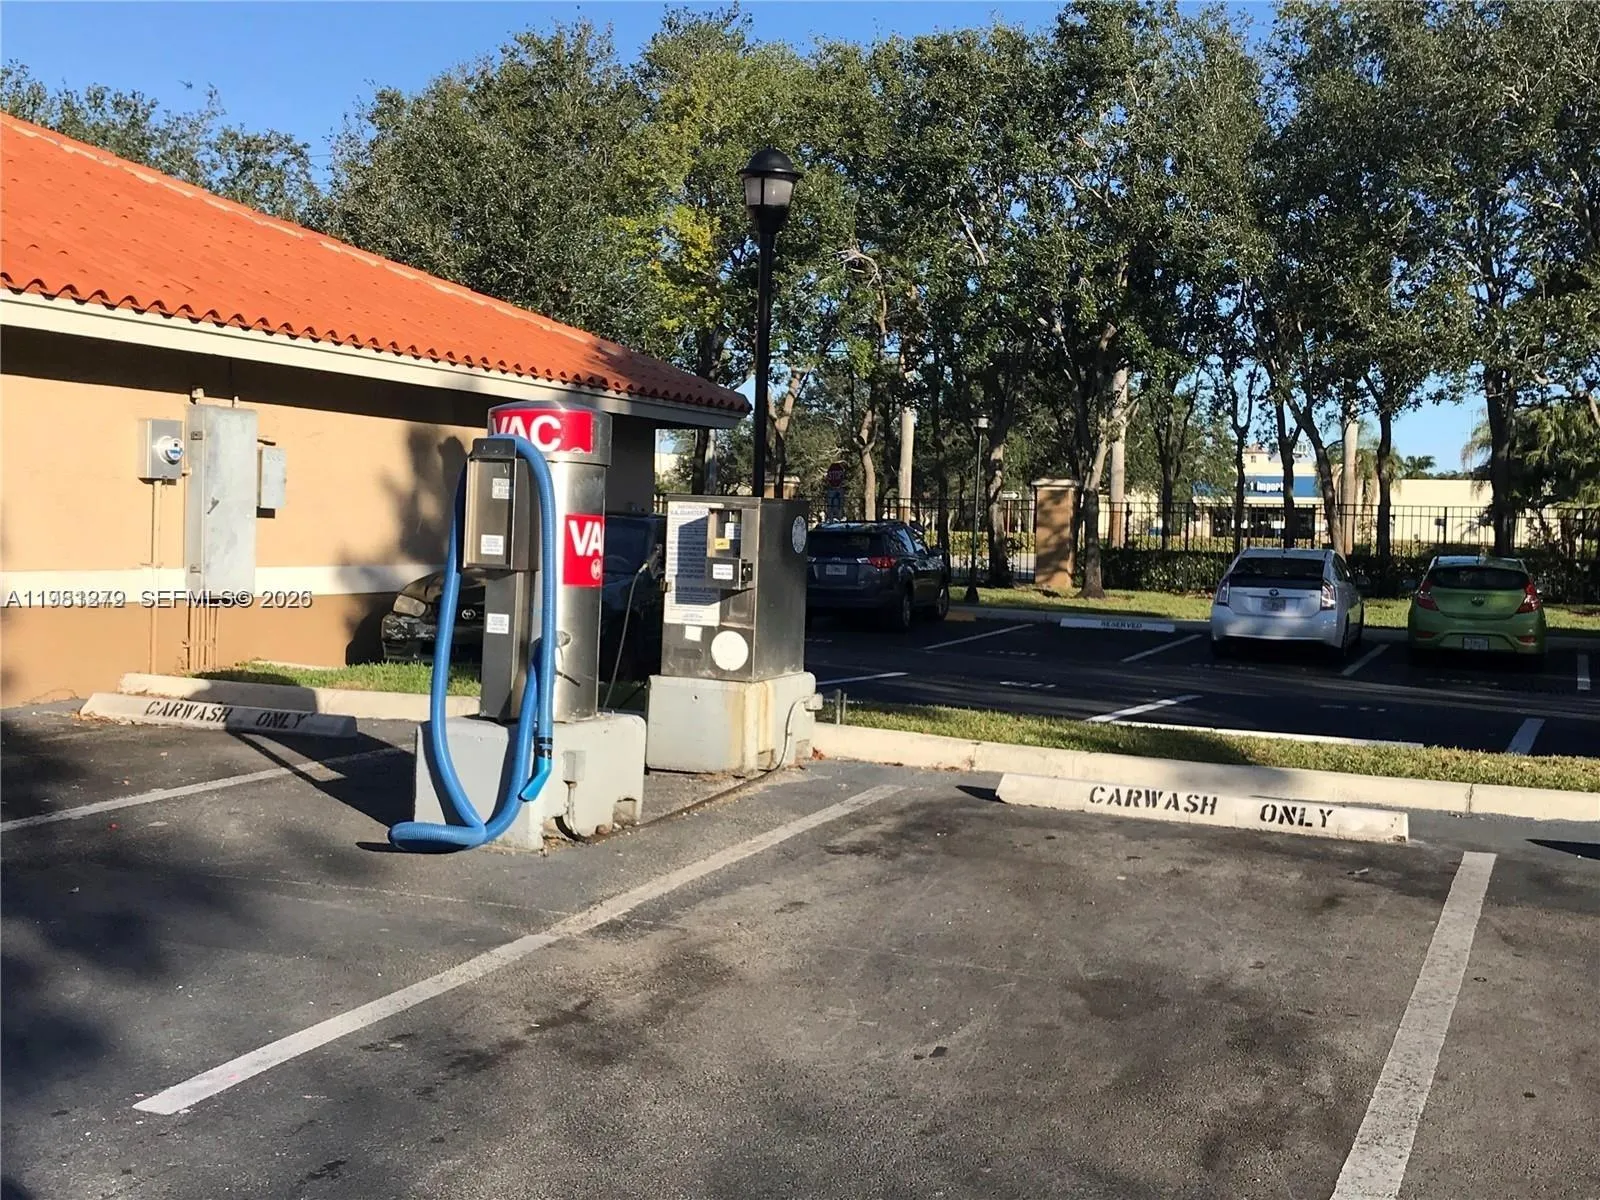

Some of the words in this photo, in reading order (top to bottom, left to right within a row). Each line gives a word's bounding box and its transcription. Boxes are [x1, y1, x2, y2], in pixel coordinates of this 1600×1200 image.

[492, 415, 562, 452] VAC
[1100, 620, 1143, 629] RESERVED
[144, 700, 233, 723] CARWASH
[255, 711, 306, 729] ONLY
[1089, 786, 1218, 816] CARWASH
[1259, 803, 1333, 828] ONLY
